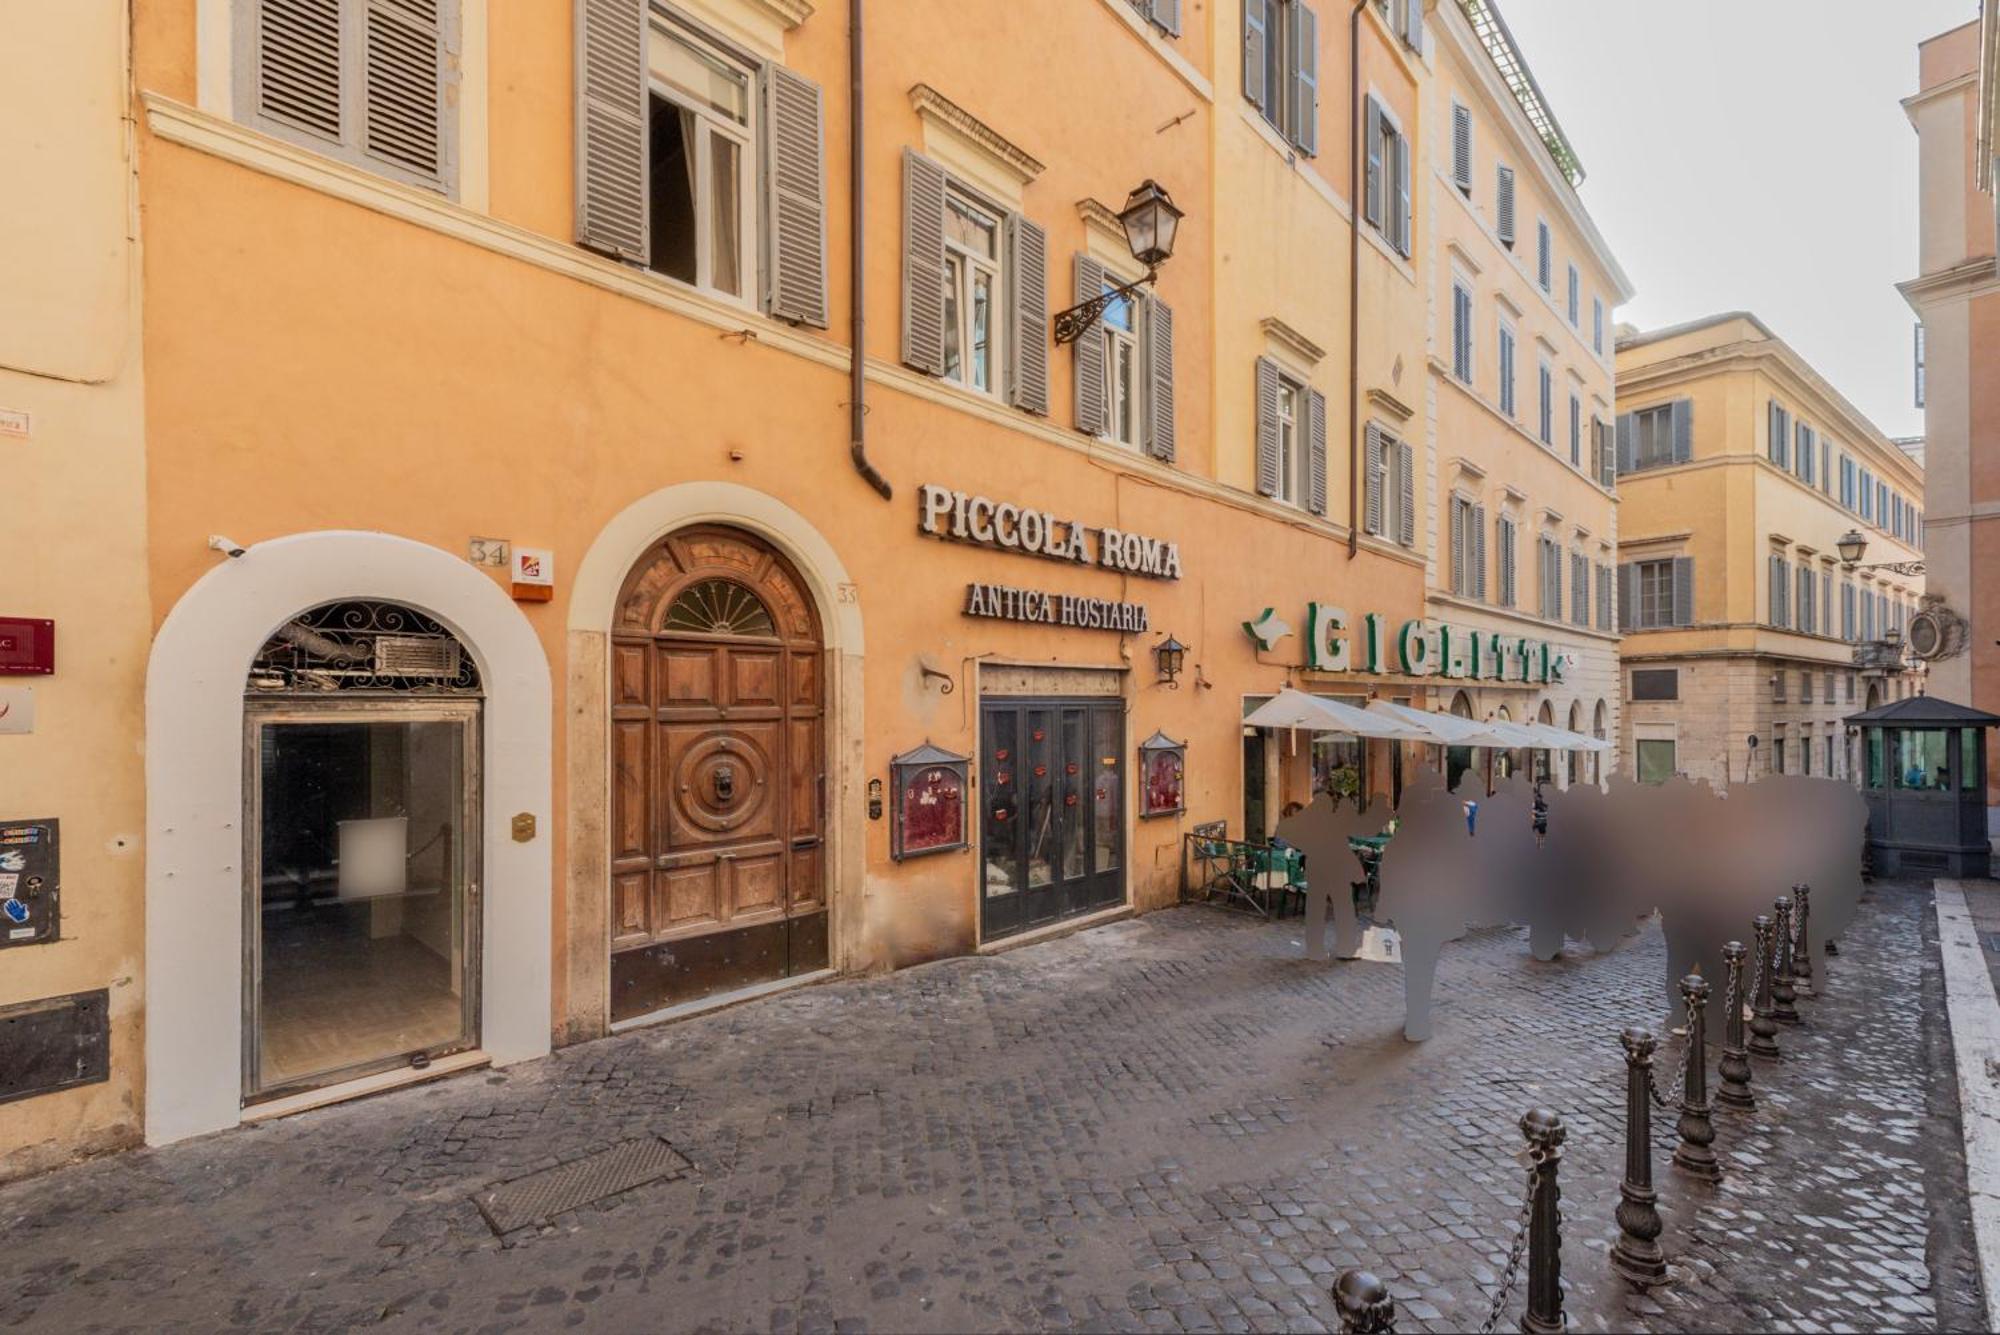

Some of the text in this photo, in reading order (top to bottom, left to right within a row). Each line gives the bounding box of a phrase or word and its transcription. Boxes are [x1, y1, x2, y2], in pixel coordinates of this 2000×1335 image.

[470, 540, 508, 566] 34
[921, 484, 1184, 579] PICCOLA ROMA
[968, 582, 1150, 632] ANTICA HOSTARIA
[1307, 601, 1552, 684] GIOLITTI
